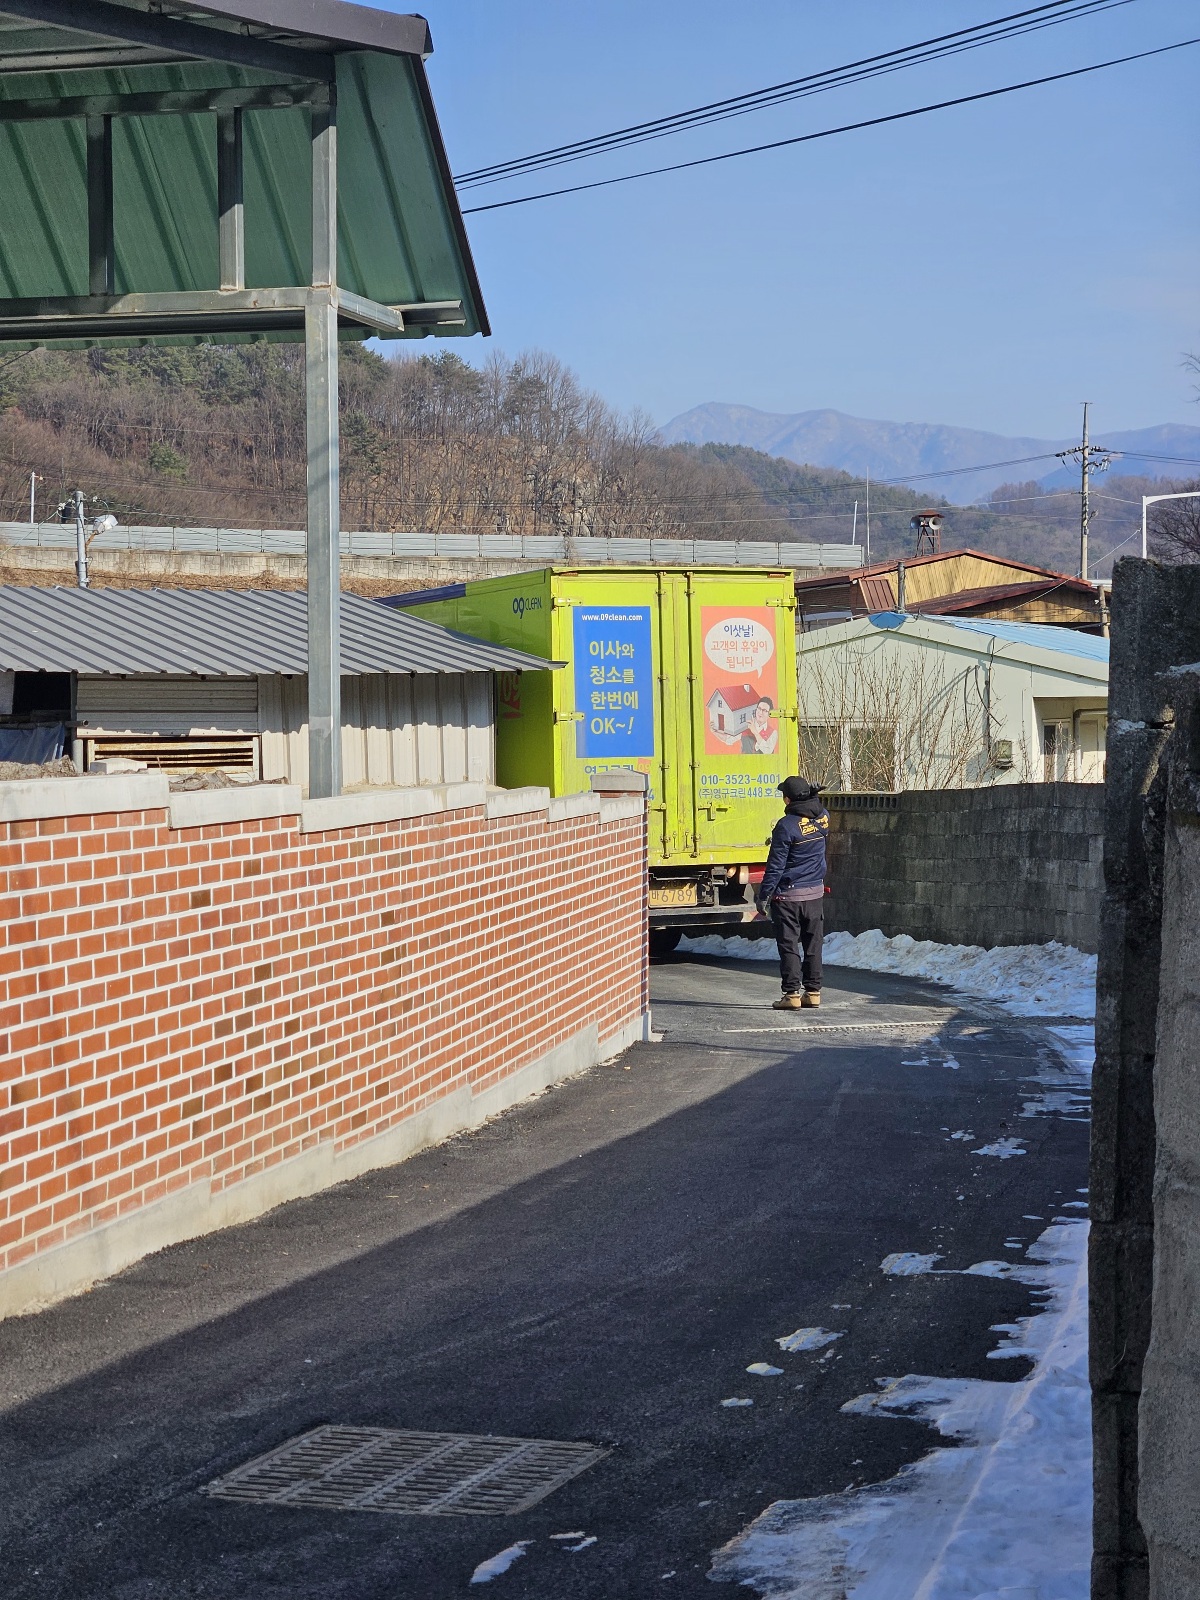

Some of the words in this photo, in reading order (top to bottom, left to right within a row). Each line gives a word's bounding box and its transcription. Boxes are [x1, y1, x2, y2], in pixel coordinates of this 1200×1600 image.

[581, 613, 643, 621] www.09clean.com
[723, 624, 754, 638] 이삿날!
[589, 640, 635, 659] 이사와
[711, 640, 738, 653] 고객의
[741, 640, 768, 653] 휴일이
[726, 656, 754, 669] 됩니다
[590, 665, 635, 685] 청소를
[590, 691, 639, 710] 한번에
[590, 716, 635, 735] OK~!
[701, 774, 781, 785] 010-3523-4001
